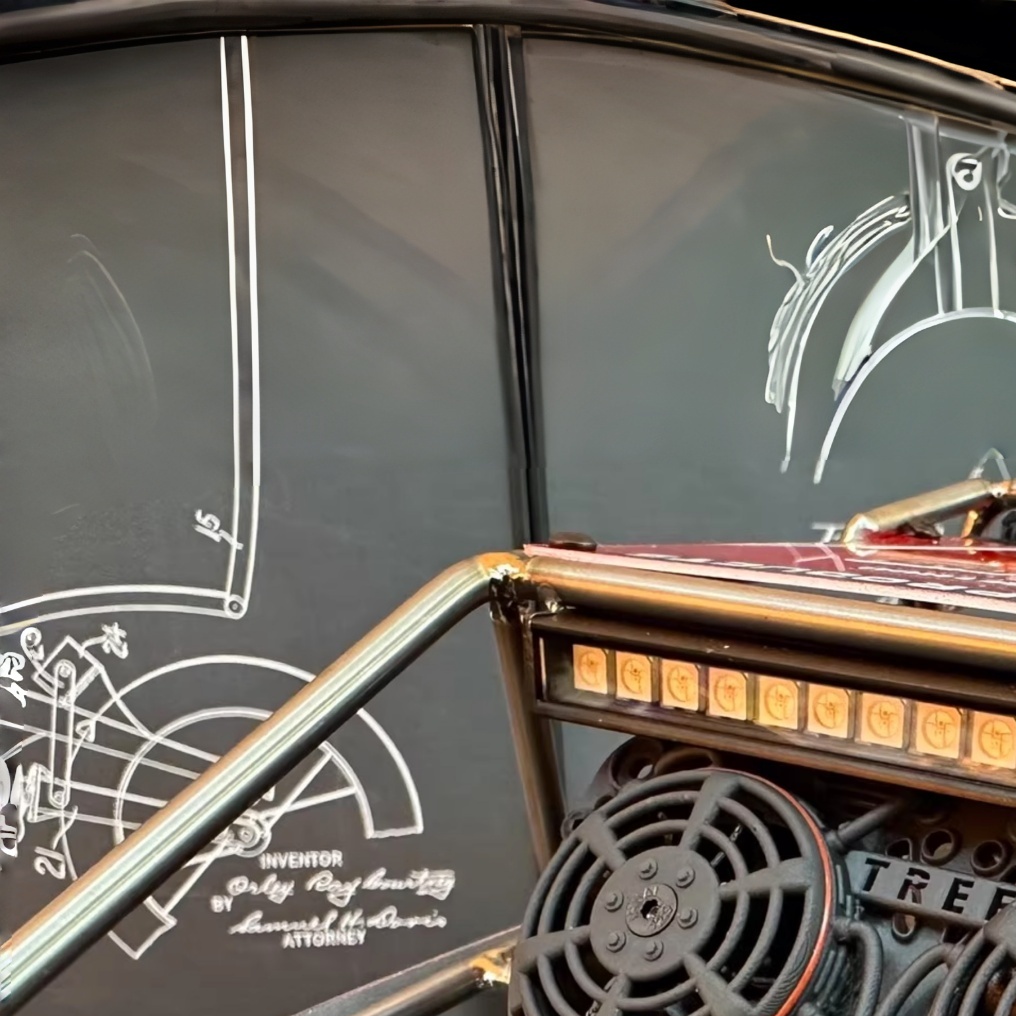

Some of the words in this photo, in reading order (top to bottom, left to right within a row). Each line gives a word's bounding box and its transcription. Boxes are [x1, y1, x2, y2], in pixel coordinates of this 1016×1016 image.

[259, 850, 343, 870] INVENTOR
[210, 894, 234, 913] BY
[282, 929, 366, 949] ATTORNEY
